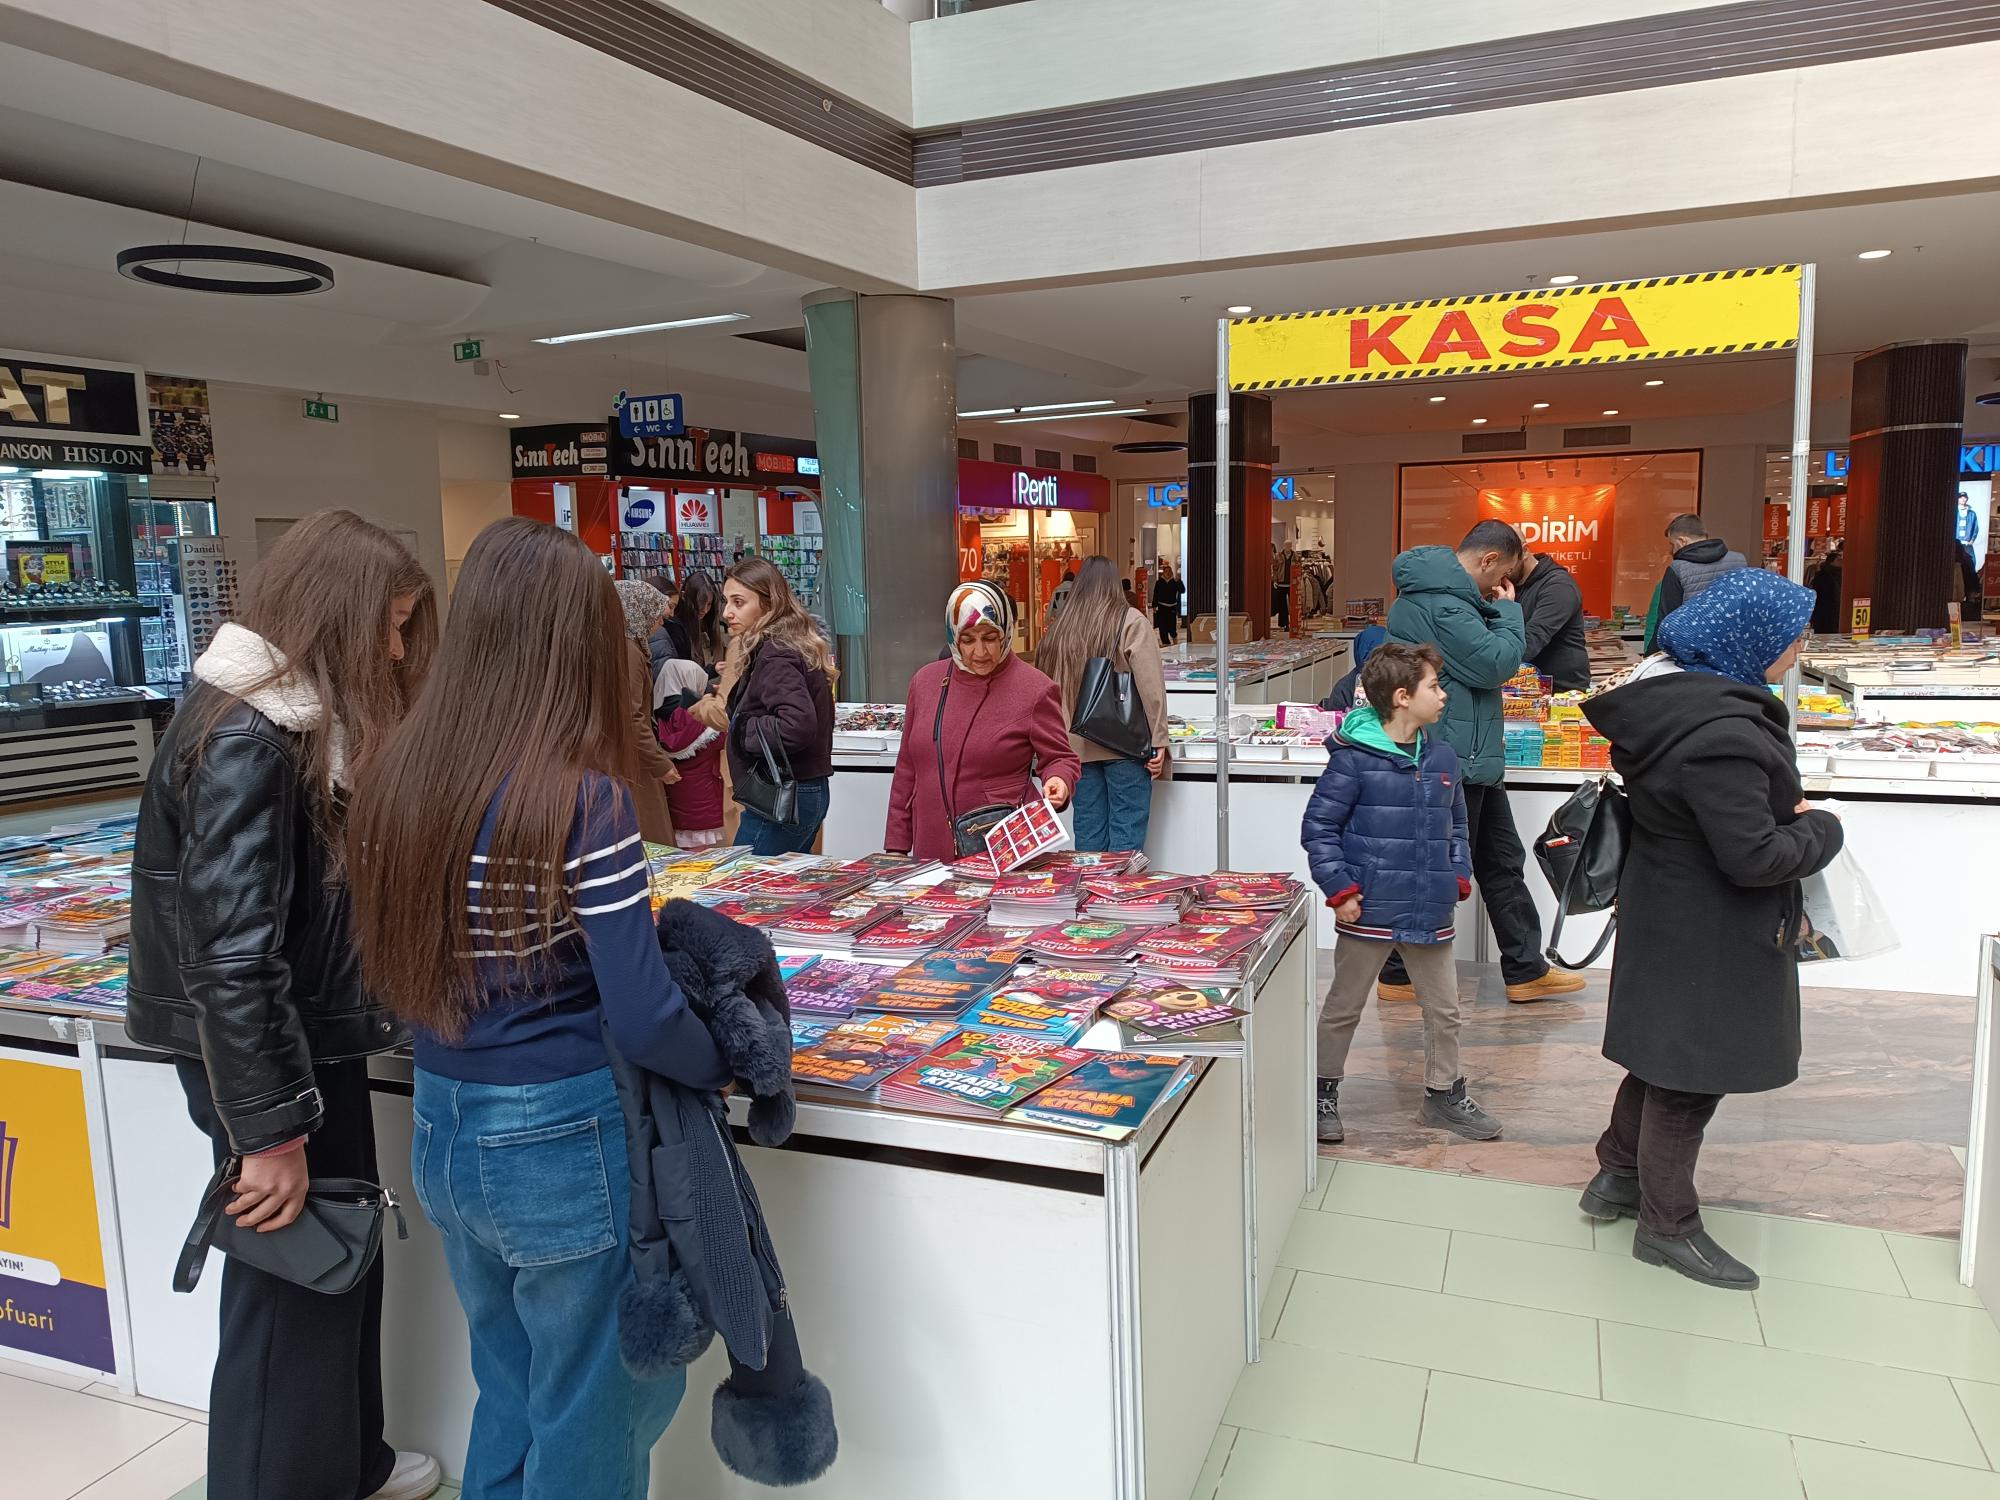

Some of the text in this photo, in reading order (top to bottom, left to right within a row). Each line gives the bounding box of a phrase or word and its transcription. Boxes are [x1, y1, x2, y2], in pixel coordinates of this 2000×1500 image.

[1349, 296, 1649, 369] KASA
[646, 424, 661, 432] WC
[62, 446, 144, 466] HISLON
[1147, 484, 1183, 507] LC
[1512, 514, 1599, 543] DİRİM
[184, 544, 216, 554] Daniel
[960, 548, 978, 573] 70
[1855, 608, 1868, 626] 50
[786, 989, 861, 1003] OYAM
[1142, 1004, 1232, 1027] BOYAMA
[927, 1068, 1012, 1095] BOYAMA
